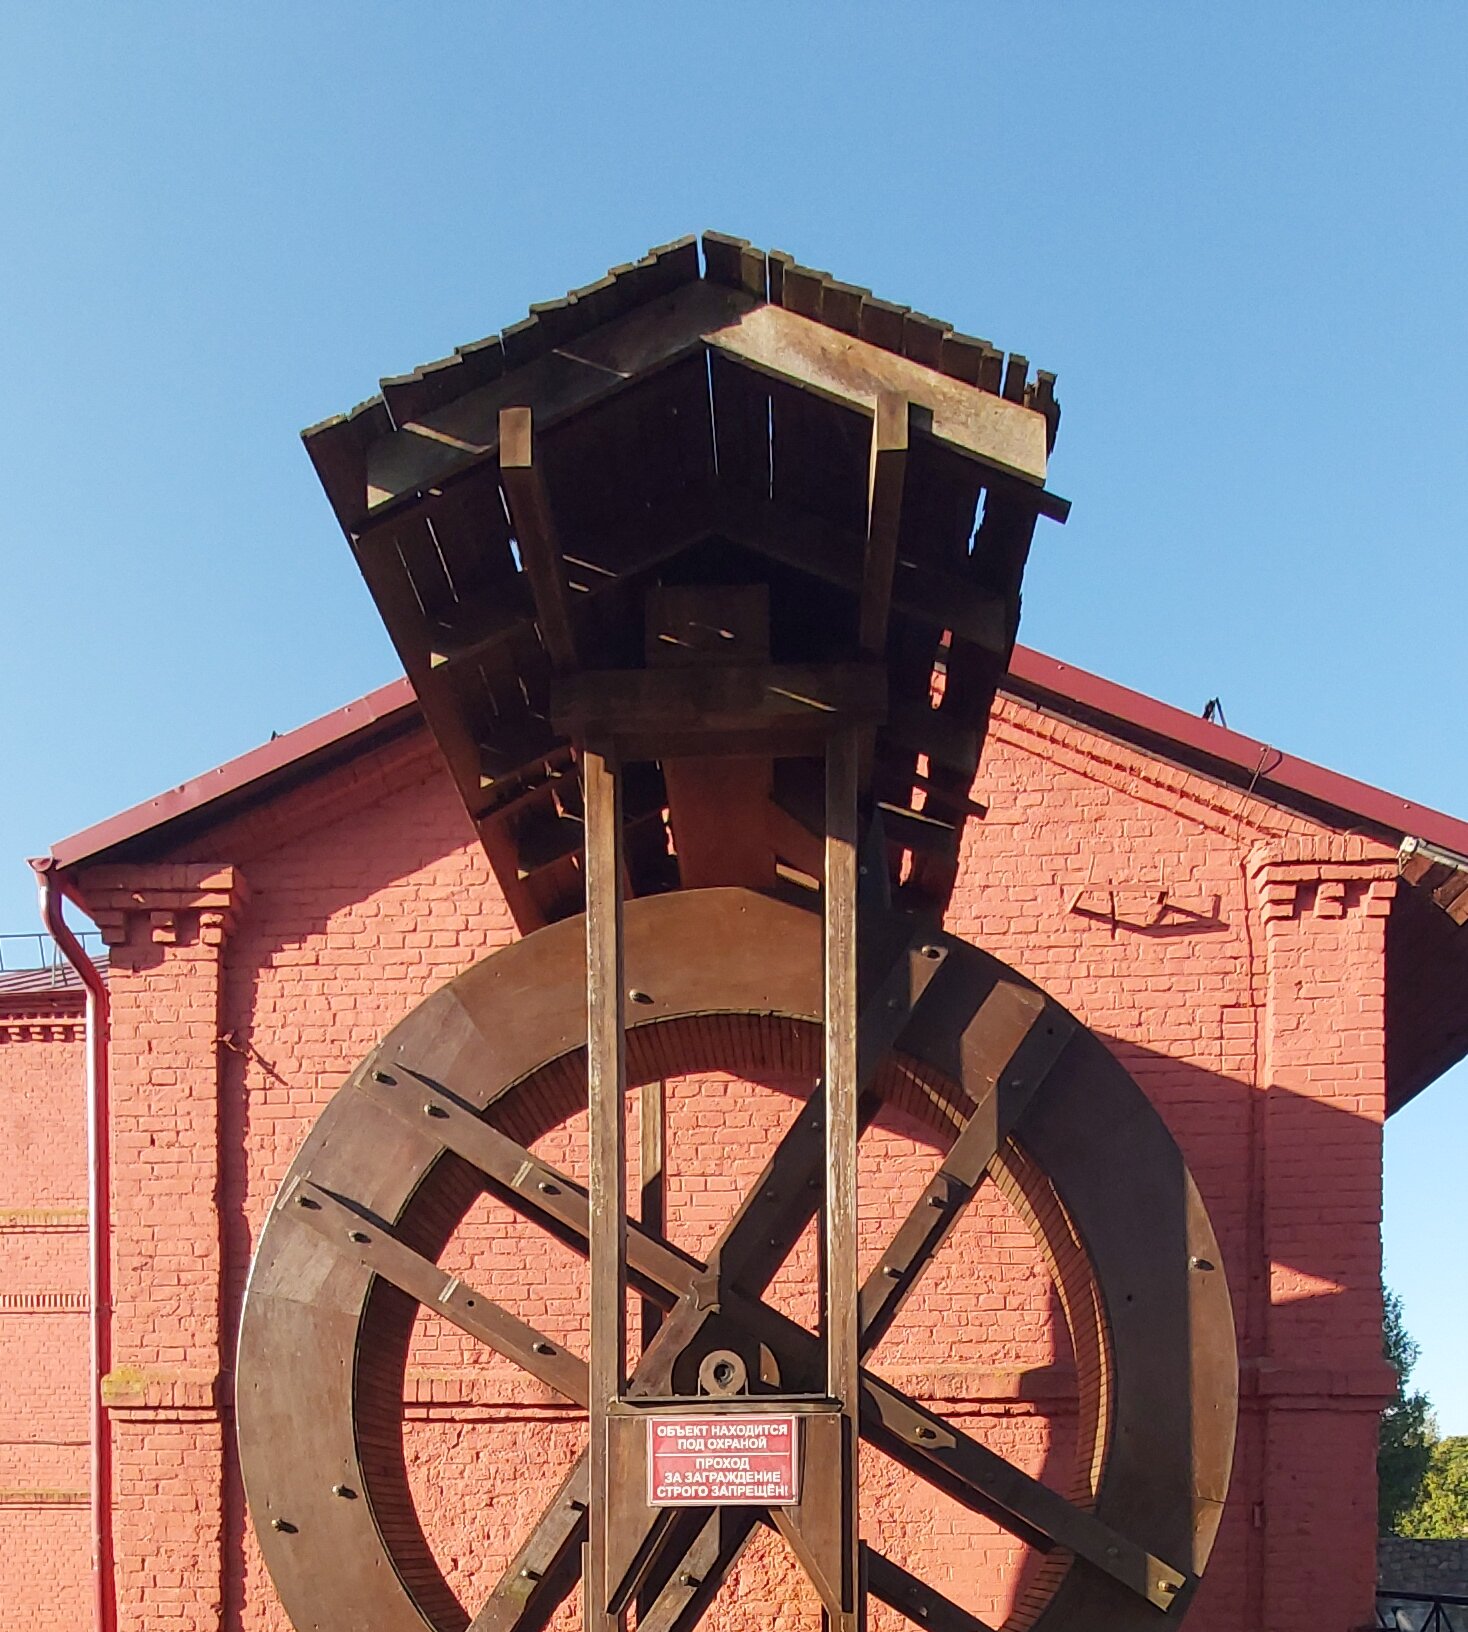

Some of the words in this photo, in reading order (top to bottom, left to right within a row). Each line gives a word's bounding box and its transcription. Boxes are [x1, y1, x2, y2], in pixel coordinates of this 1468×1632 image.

[657, 1425, 709, 1437] ОБЪЕКТ
[711, 1424, 788, 1437] НАХОДИТСЯ
[678, 1439, 705, 1451] ПОД
[707, 1436, 767, 1449] ОХРАНОЙ
[696, 1457, 750, 1470] ПРОХОД
[664, 1472, 682, 1483] ЗА
[684, 1471, 781, 1484] ЗАГРАЖДЕНИЕ
[657, 1486, 709, 1497] СТРОГО
